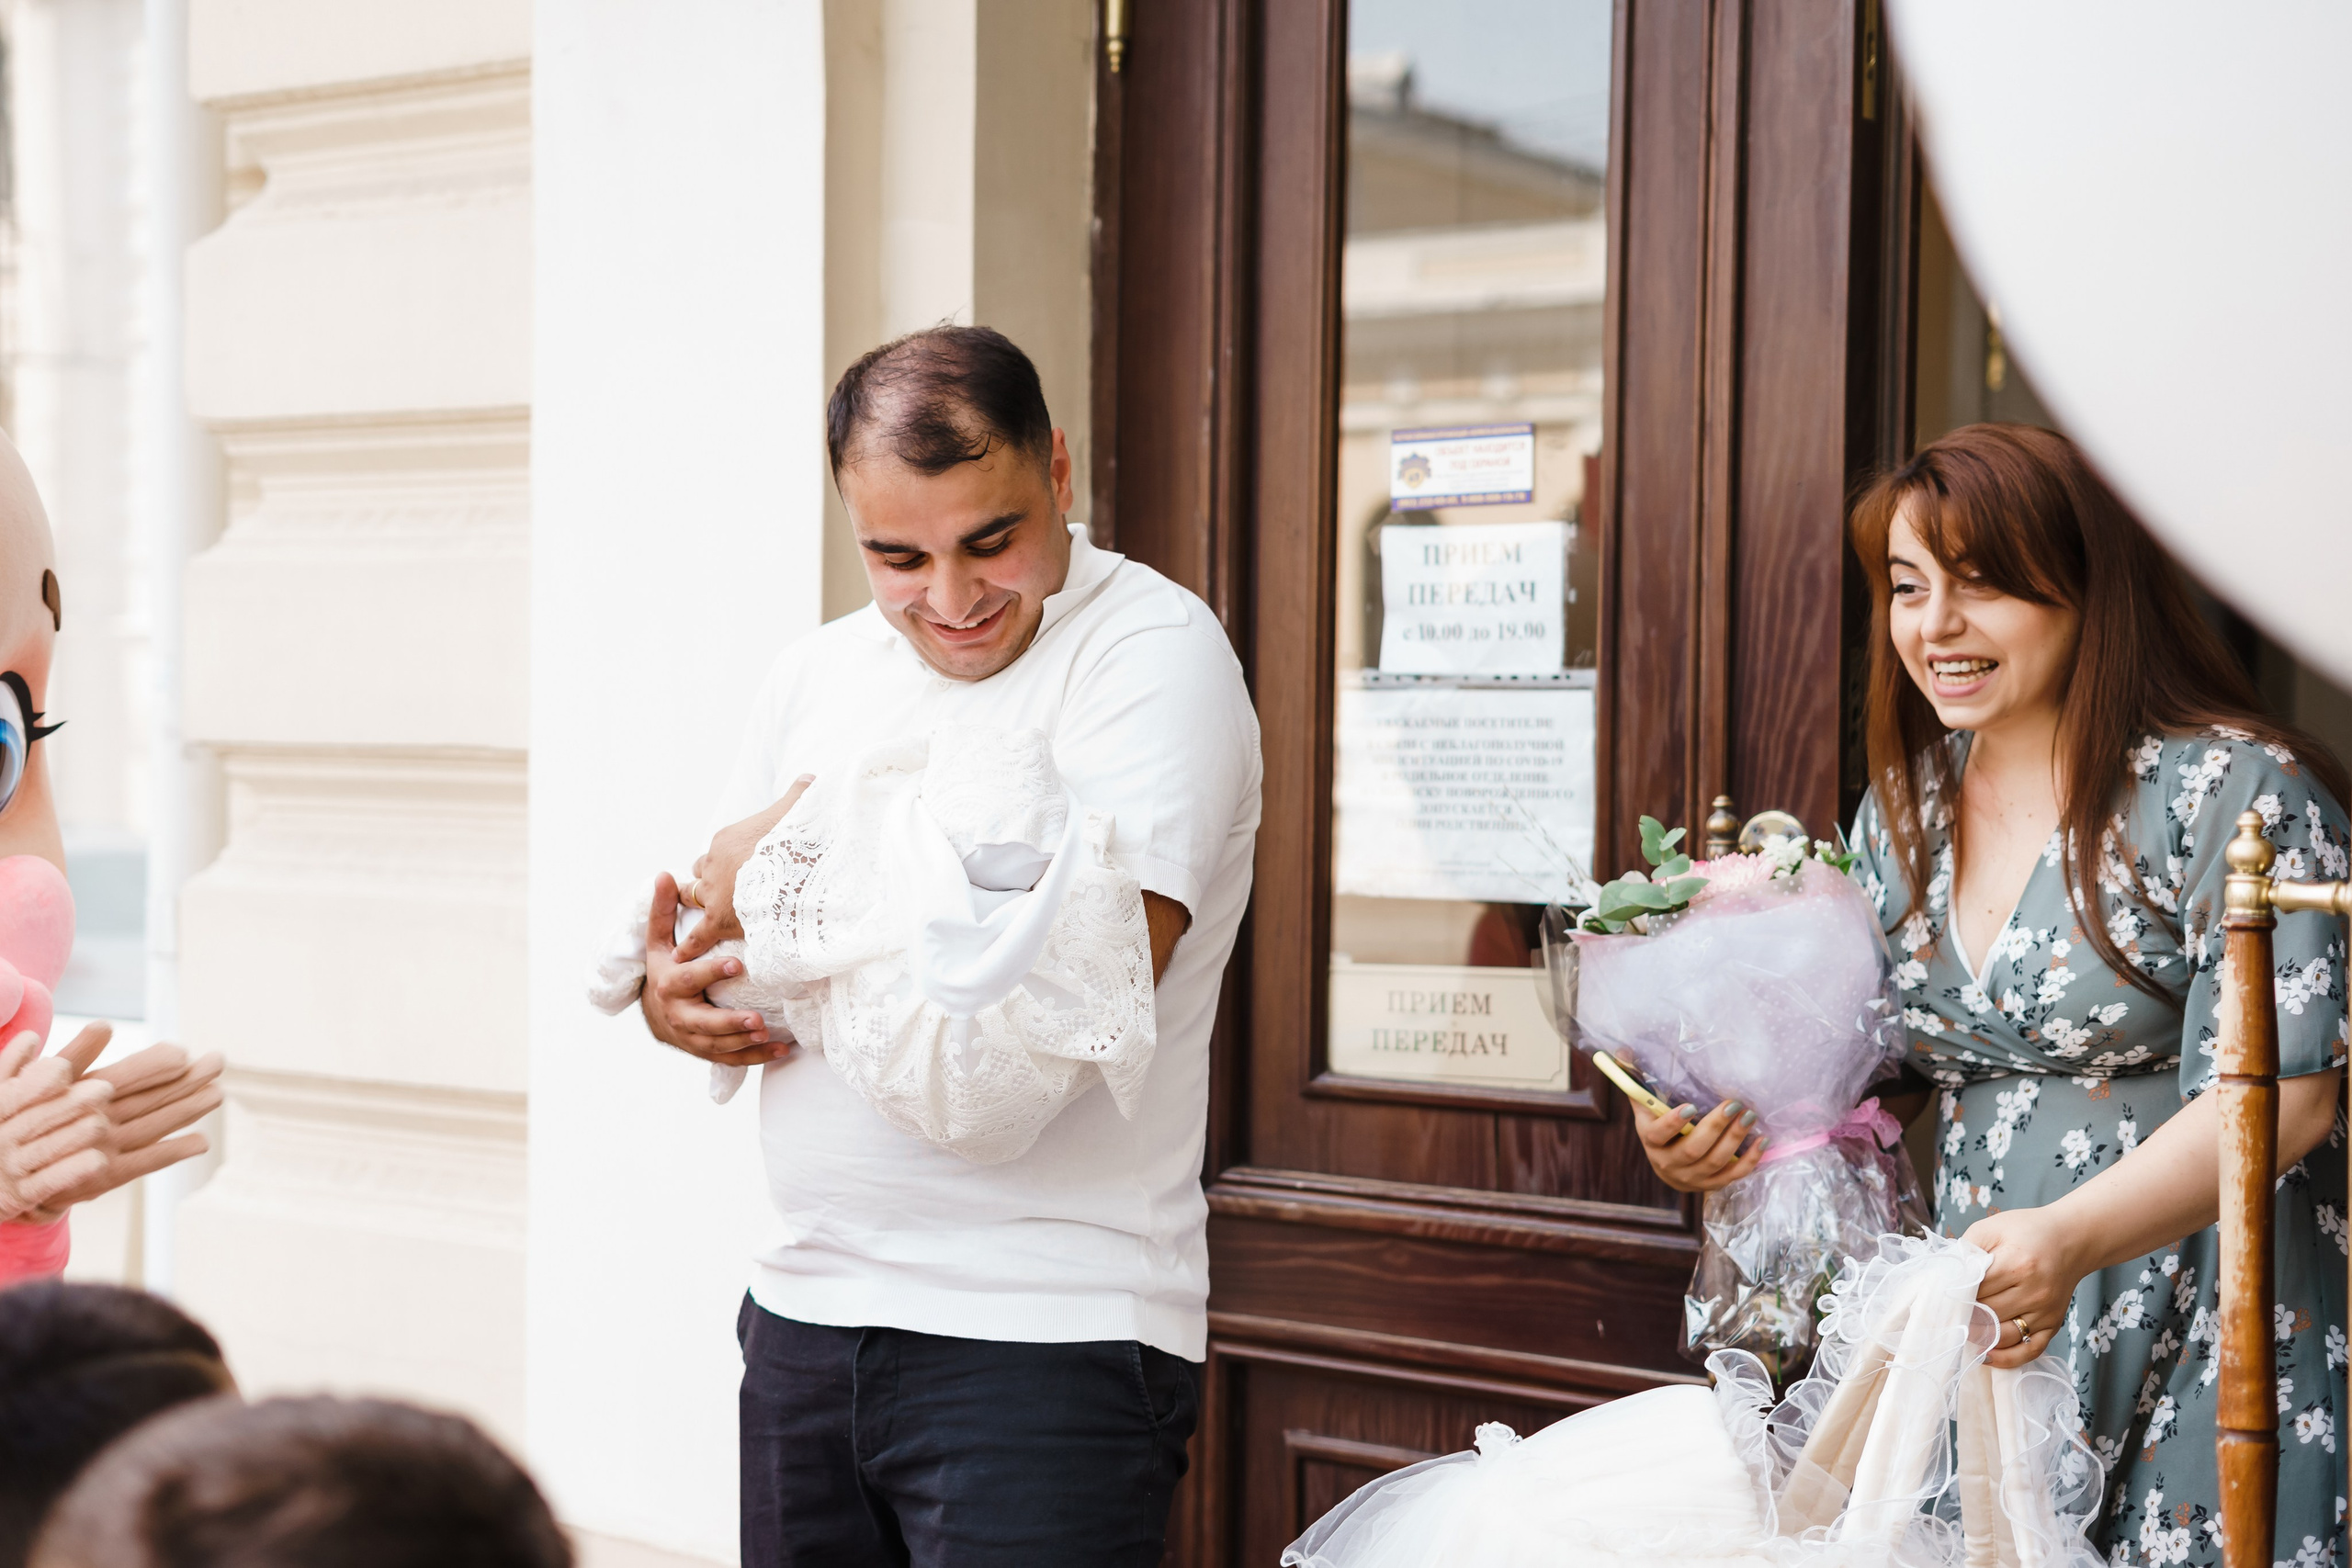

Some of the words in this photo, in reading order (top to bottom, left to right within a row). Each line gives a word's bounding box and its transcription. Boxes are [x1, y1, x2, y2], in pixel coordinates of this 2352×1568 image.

[1423, 543, 1521, 566] ПРИЕМ
[1408, 581, 1536, 606] ПЕРЕДАЧ
[1403, 627, 1412, 640] с
[1419, 623, 1463, 641] 10.00
[1469, 627, 1490, 641] до
[1498, 622, 1546, 640] 19.00
[1387, 990, 1493, 1016] ПРИЕМ
[1372, 1028, 1508, 1056] ПЕРЕДАЧ
